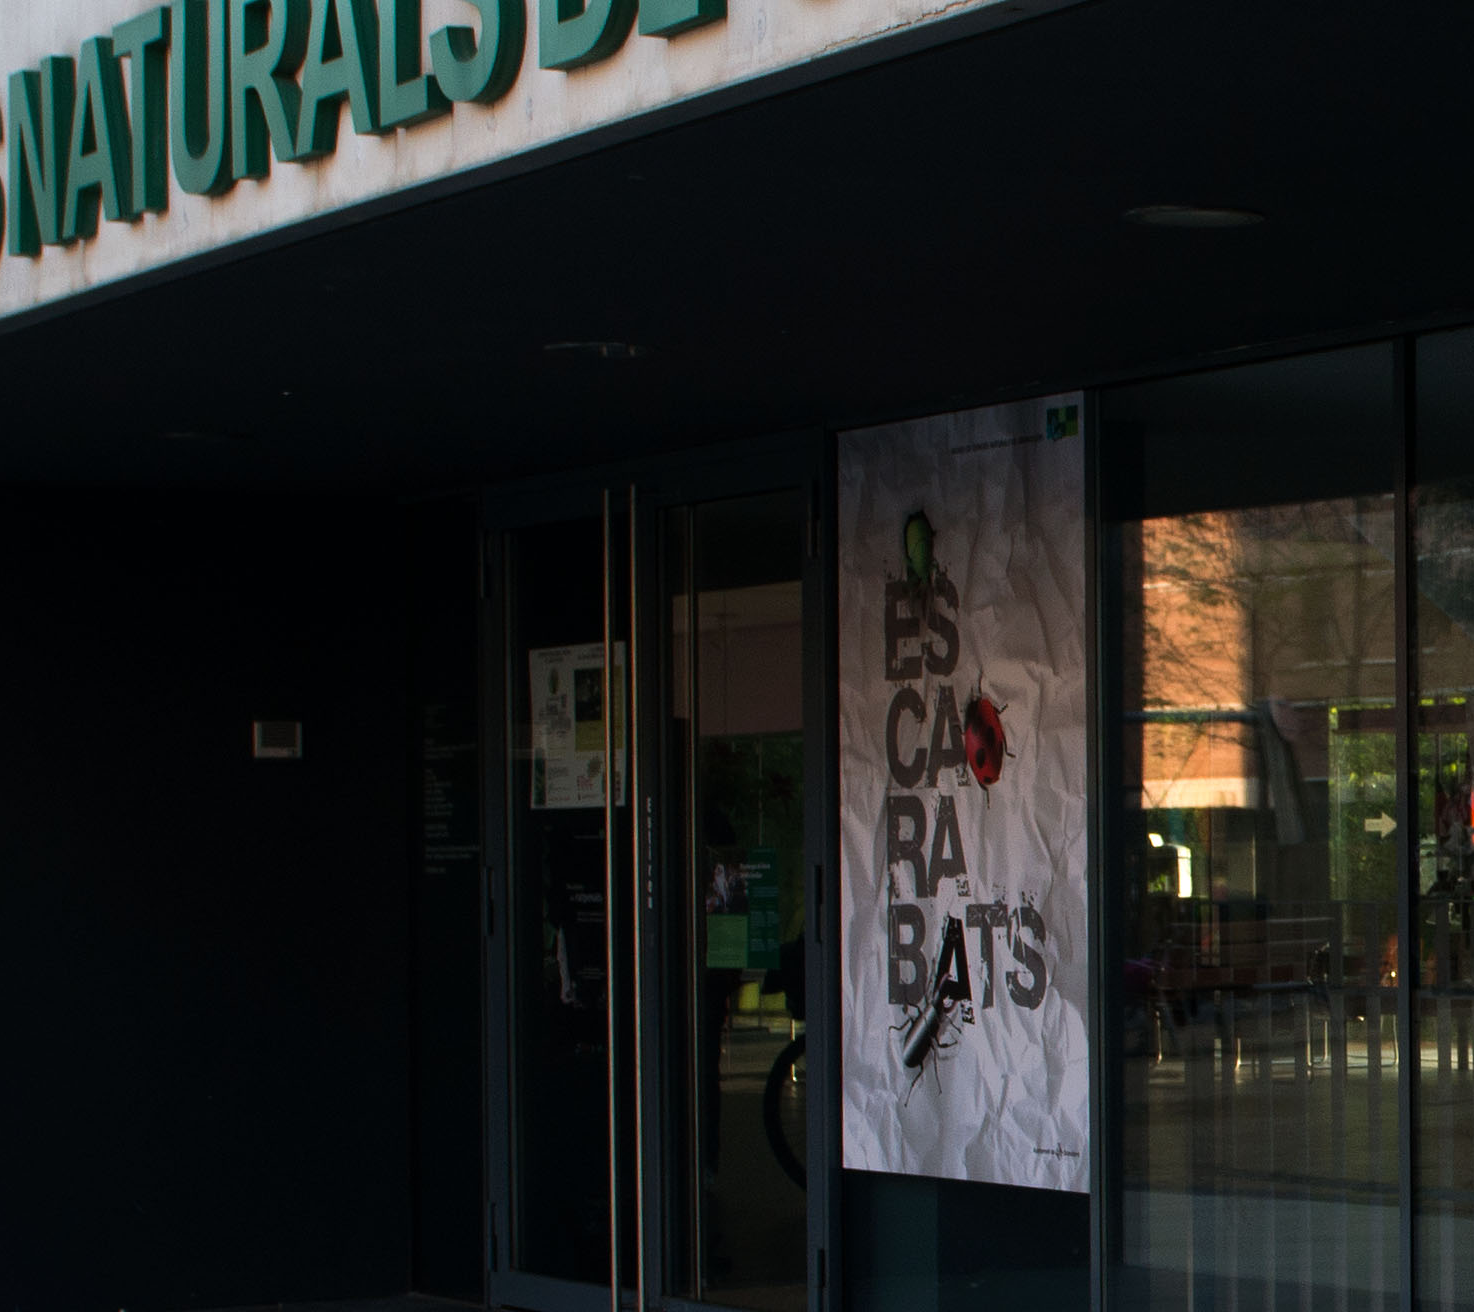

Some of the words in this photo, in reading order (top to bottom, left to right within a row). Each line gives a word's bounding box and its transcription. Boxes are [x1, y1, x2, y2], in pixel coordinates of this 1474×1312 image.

[884, 572, 960, 680] ES
[886, 686, 970, 789] CA
[887, 794, 971, 898] RA
[887, 900, 1047, 1025] BATS
